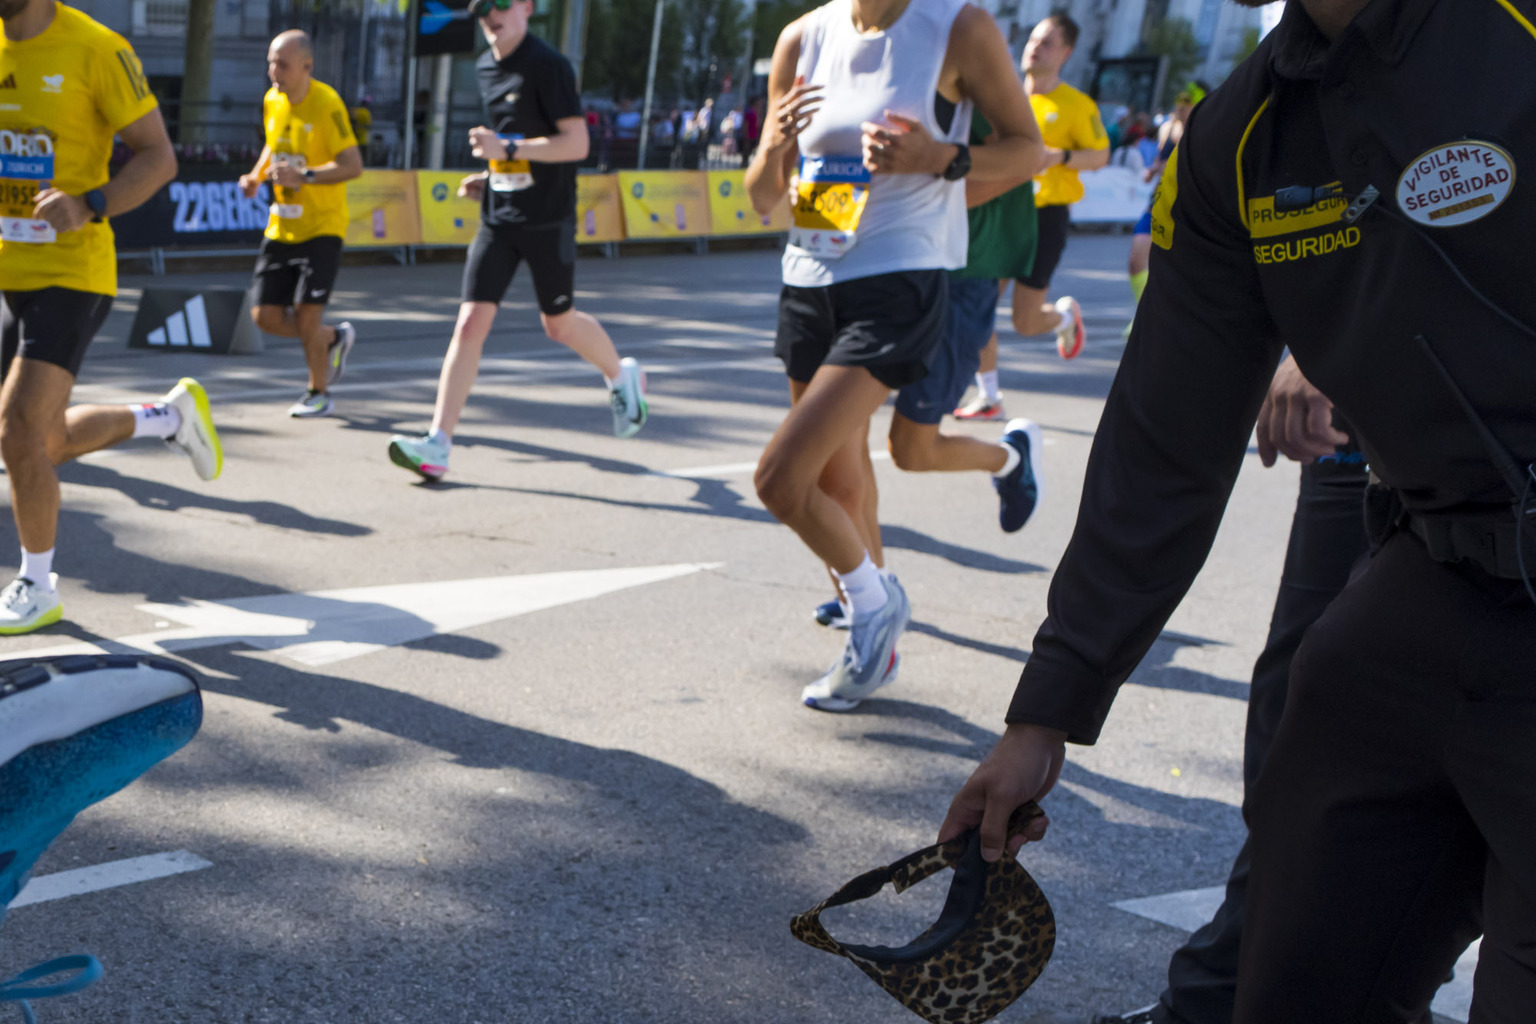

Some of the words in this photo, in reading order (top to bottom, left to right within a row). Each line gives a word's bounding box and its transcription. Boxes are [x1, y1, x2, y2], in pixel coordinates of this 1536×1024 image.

[821, 162, 864, 176] URICH
[1405, 147, 1496, 192] VIGILANTE
[1439, 166, 1460, 183] DE
[1405, 168, 1509, 211] SEGURIDAD
[1253, 226, 1361, 264] SEGURIDAD
